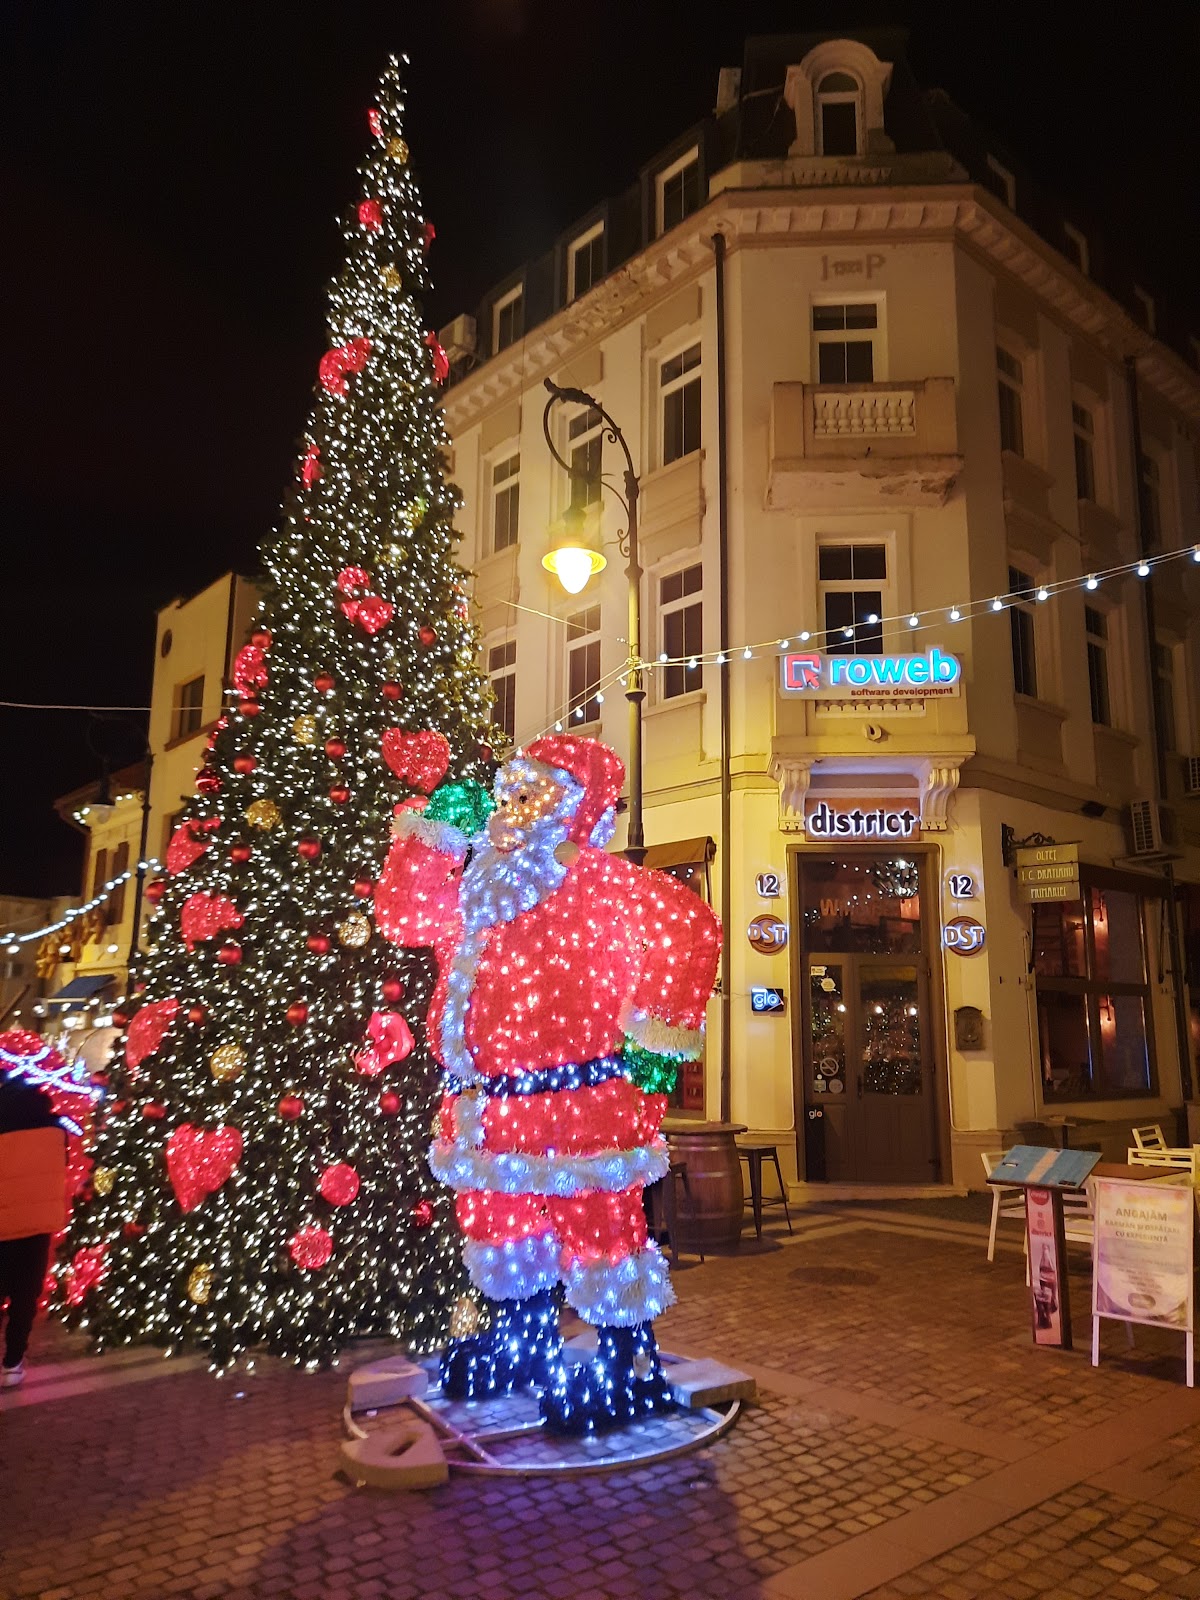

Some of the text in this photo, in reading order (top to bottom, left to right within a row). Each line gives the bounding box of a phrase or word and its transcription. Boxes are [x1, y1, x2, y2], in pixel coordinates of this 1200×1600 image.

[830, 649, 958, 685] roweb
[850, 687, 953, 697] software development
[810, 802, 915, 836] district
[757, 873, 779, 895] 12
[950, 875, 974, 897] 12
[748, 921, 787, 944] DST
[945, 925, 984, 948] DST
[753, 989, 779, 1010] glo
[808, 1109, 823, 1120] glo
